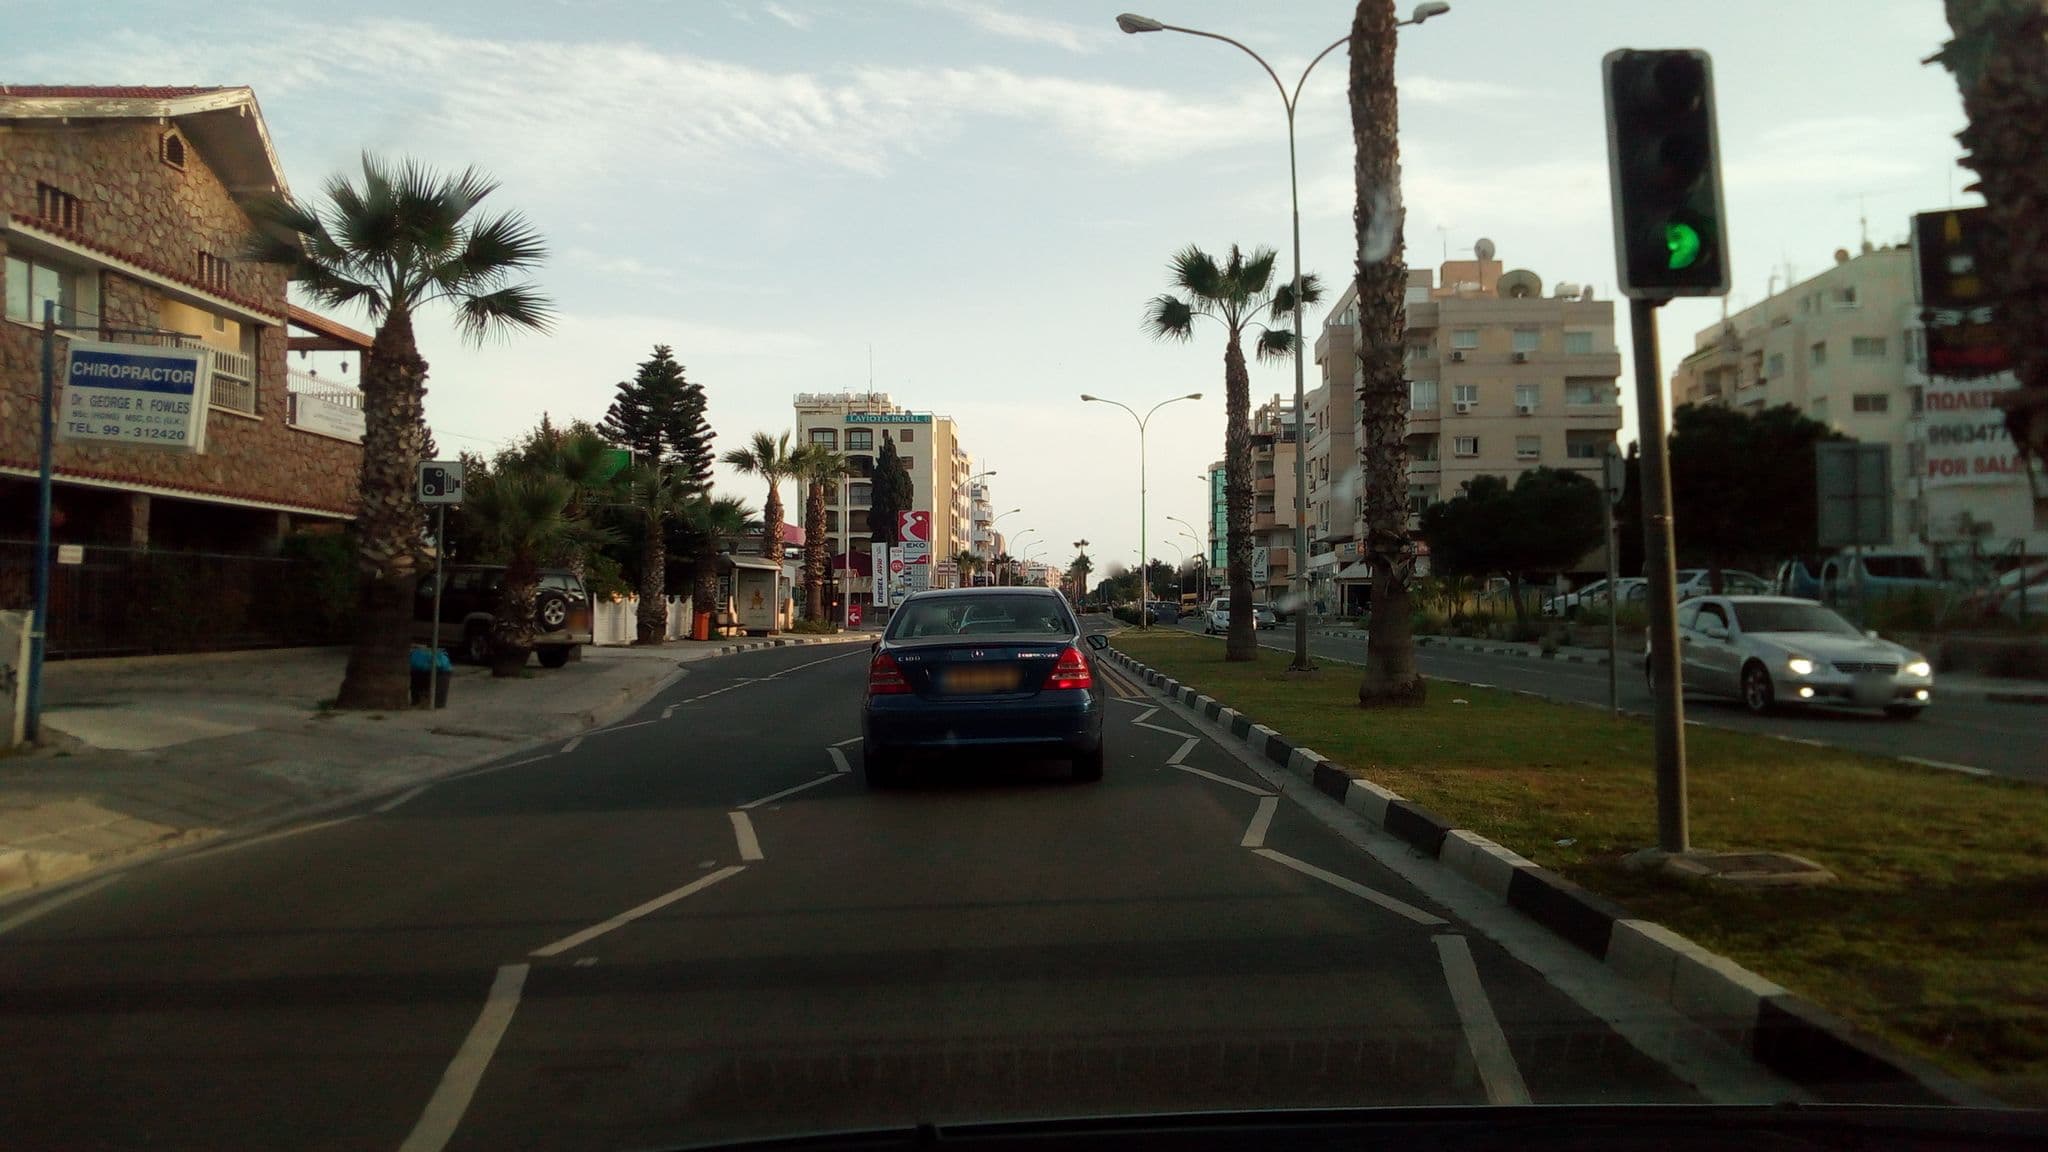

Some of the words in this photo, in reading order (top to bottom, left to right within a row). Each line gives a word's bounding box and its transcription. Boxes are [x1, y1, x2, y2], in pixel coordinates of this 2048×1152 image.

[72, 361, 194, 384] CHIROPRACTOR
[90, 395, 130, 410] GEORGE
[150, 400, 190, 415] FOWLES
[892, 415, 921, 423] HOTEL
[103, 425, 120, 436] 99
[133, 427, 185, 440] 312420
[1928, 458, 1967, 477] FOR
